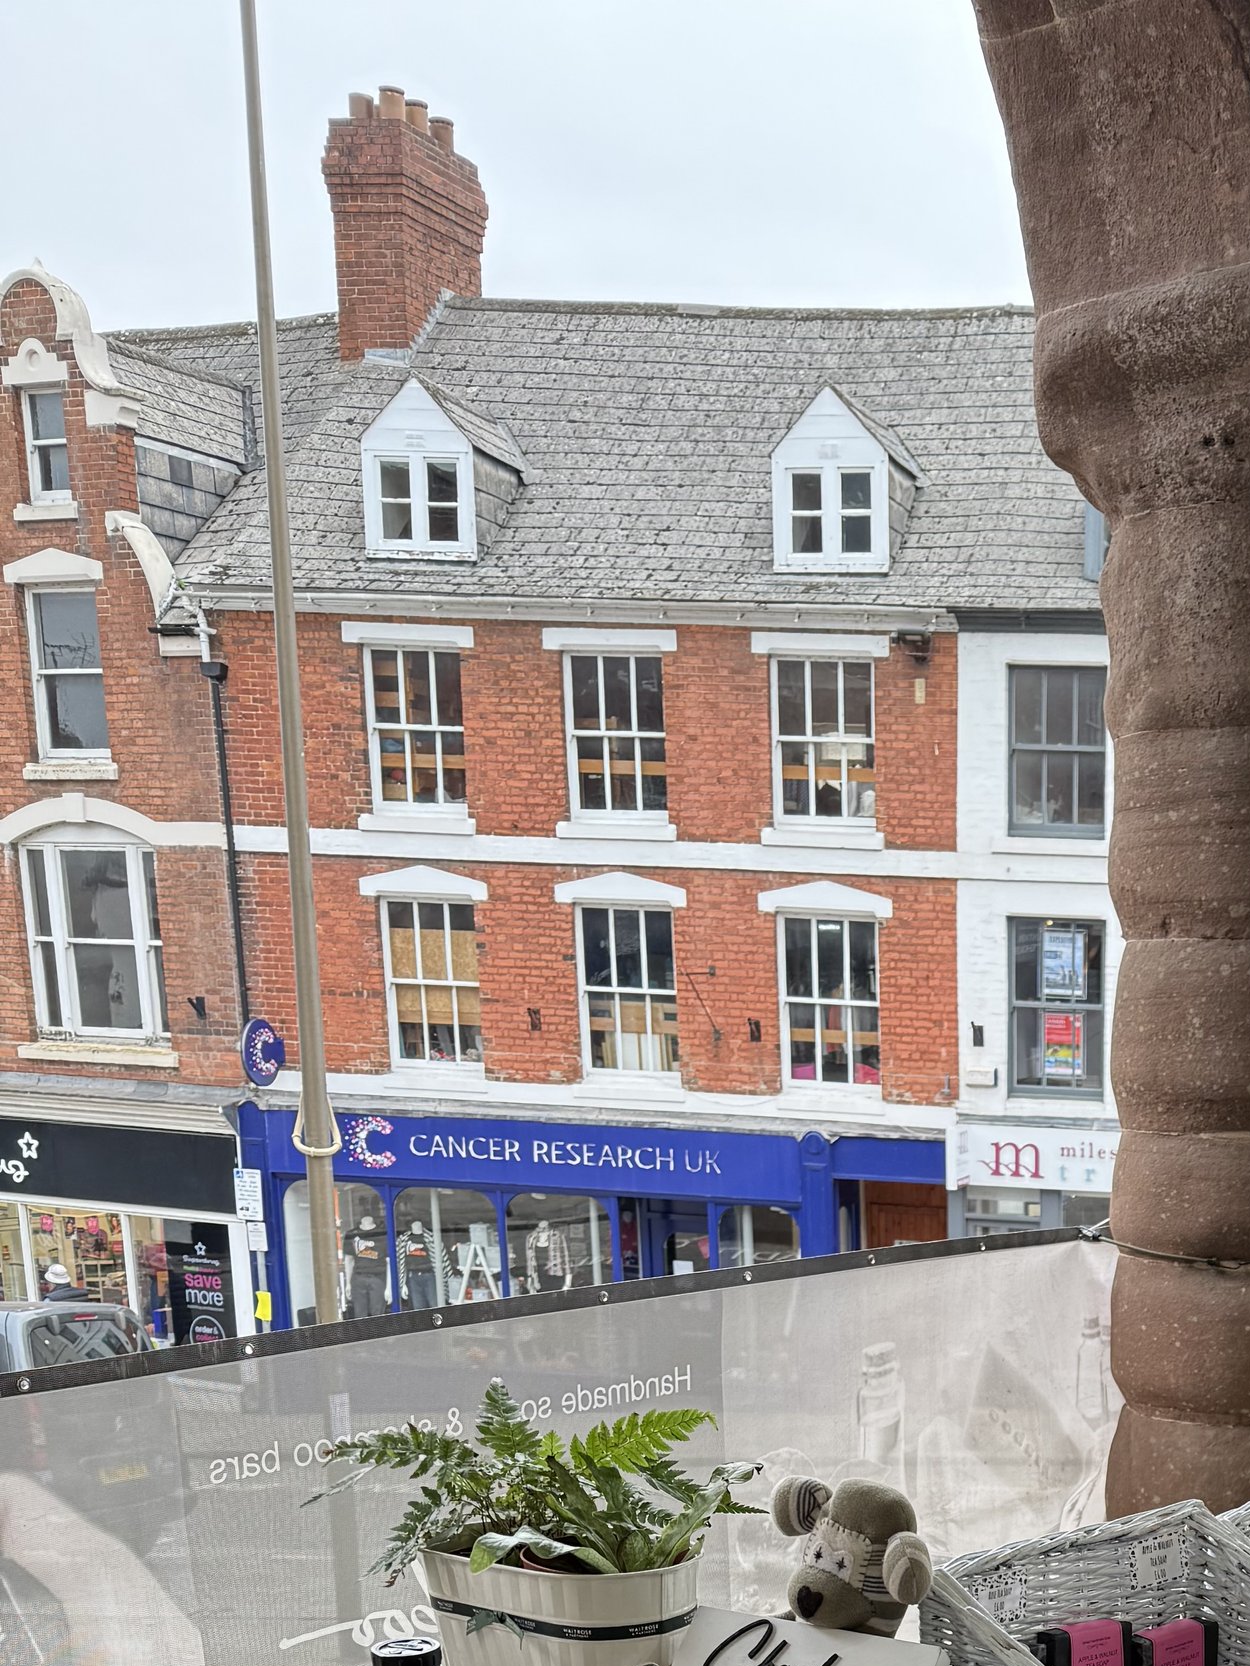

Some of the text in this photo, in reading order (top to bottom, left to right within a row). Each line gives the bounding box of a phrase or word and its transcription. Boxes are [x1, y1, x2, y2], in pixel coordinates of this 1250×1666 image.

[409, 1134, 521, 1163] CANCER
[533, 1140, 675, 1172] RESEARCH
[685, 1149, 722, 1175] UK
[185, 1272, 222, 1289] save
[185, 1290, 224, 1307] more
[629, 1623, 659, 1633] WAITROSE
